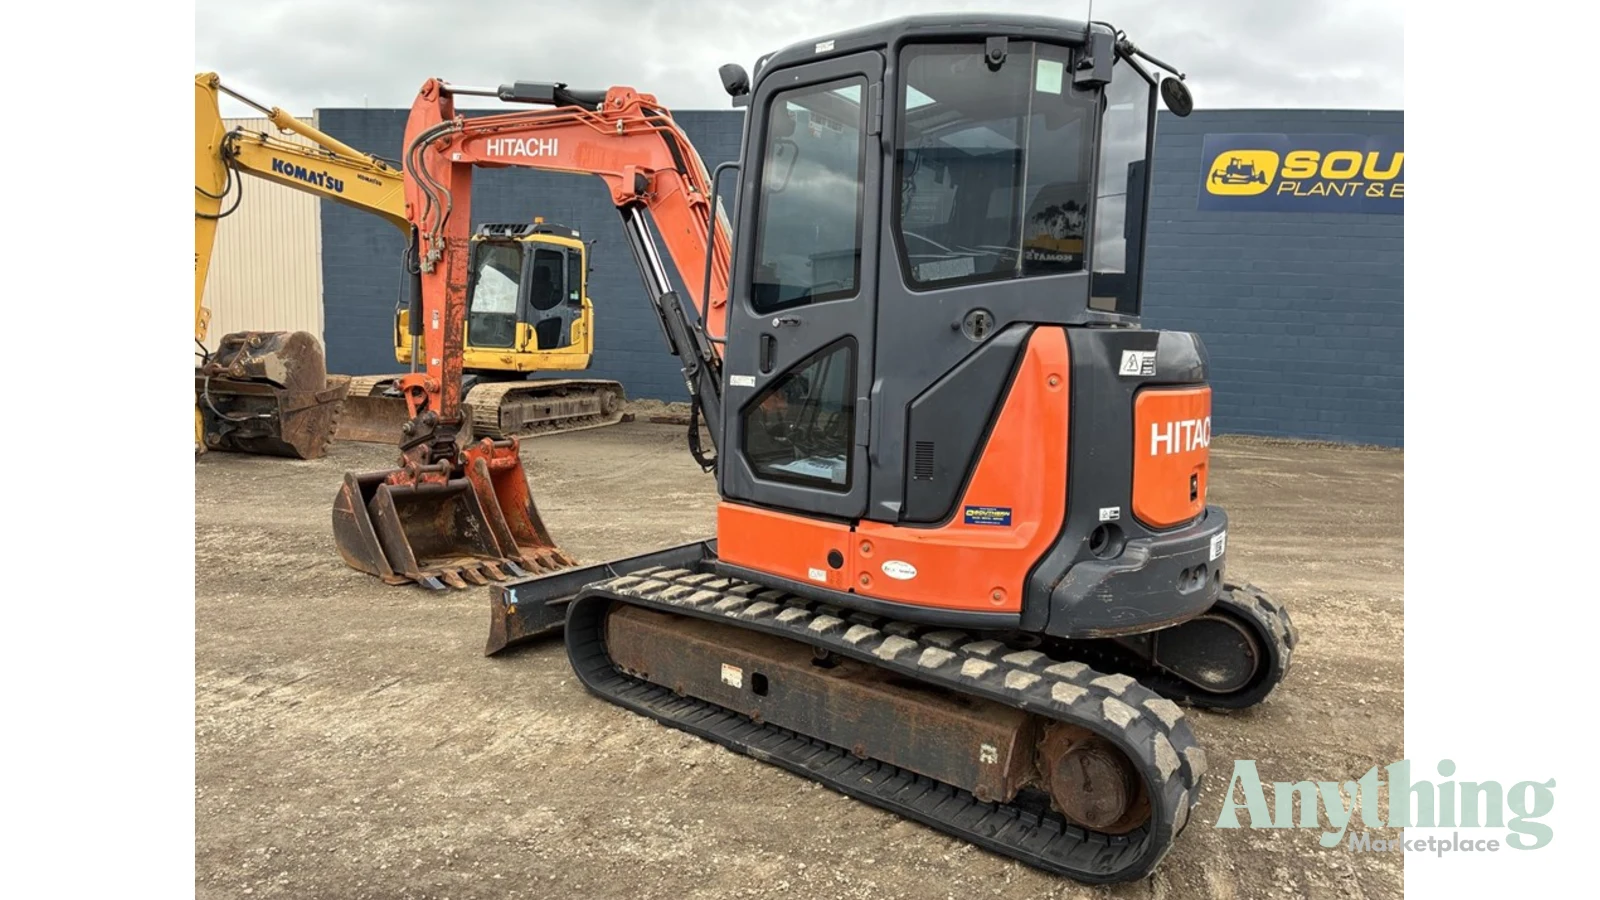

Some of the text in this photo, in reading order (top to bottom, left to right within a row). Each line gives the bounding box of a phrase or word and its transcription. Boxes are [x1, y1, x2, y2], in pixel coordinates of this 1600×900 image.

[486, 138, 559, 157] HITACHI
[272, 157, 344, 193] KOMATSU
[1281, 150, 1404, 180] SOU
[1276, 181, 1364, 197] PLANT
[1365, 182, 1385, 198] &
